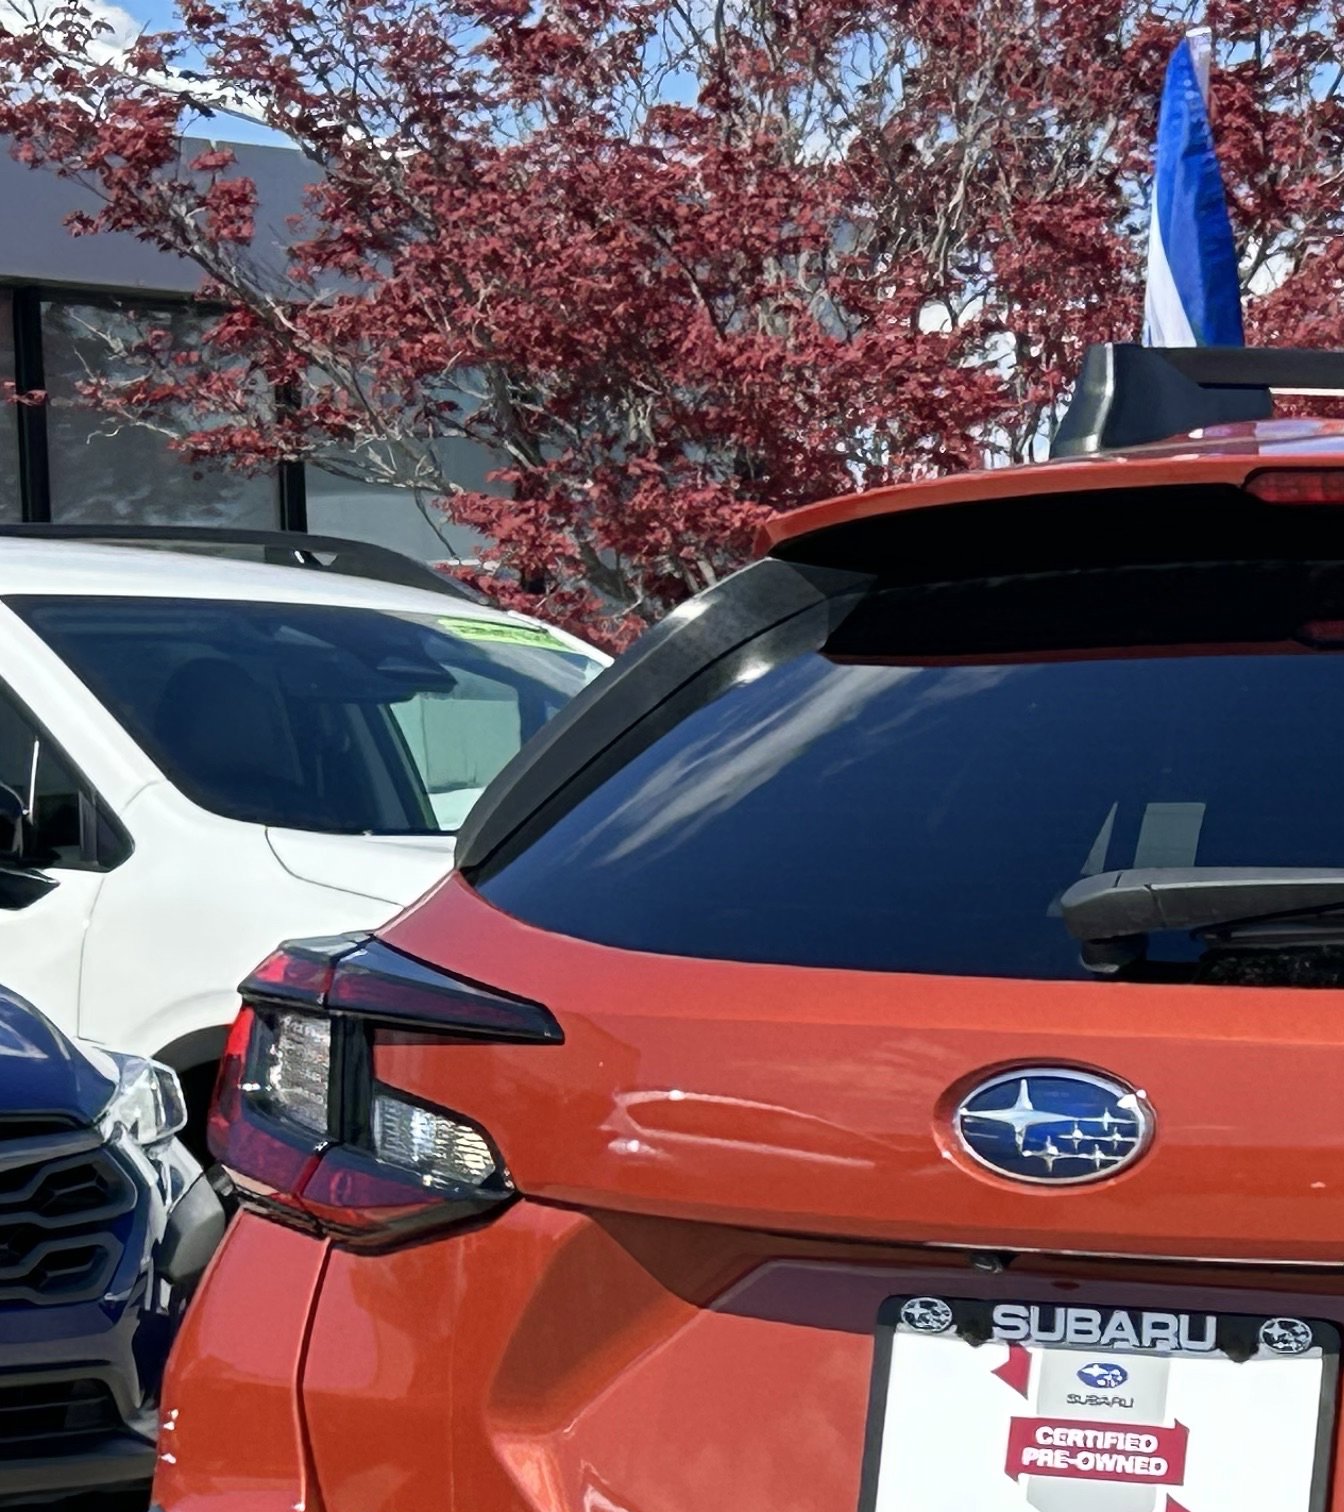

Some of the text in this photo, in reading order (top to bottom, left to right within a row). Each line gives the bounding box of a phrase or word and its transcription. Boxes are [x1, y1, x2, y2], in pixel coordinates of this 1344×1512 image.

[993, 1304, 1217, 1350] SUBARU
[1066, 1393, 1135, 1409] SUBARU
[1035, 1426, 1159, 1453] CERTIFIED
[1021, 1447, 1168, 1476] PRE-OWNED
